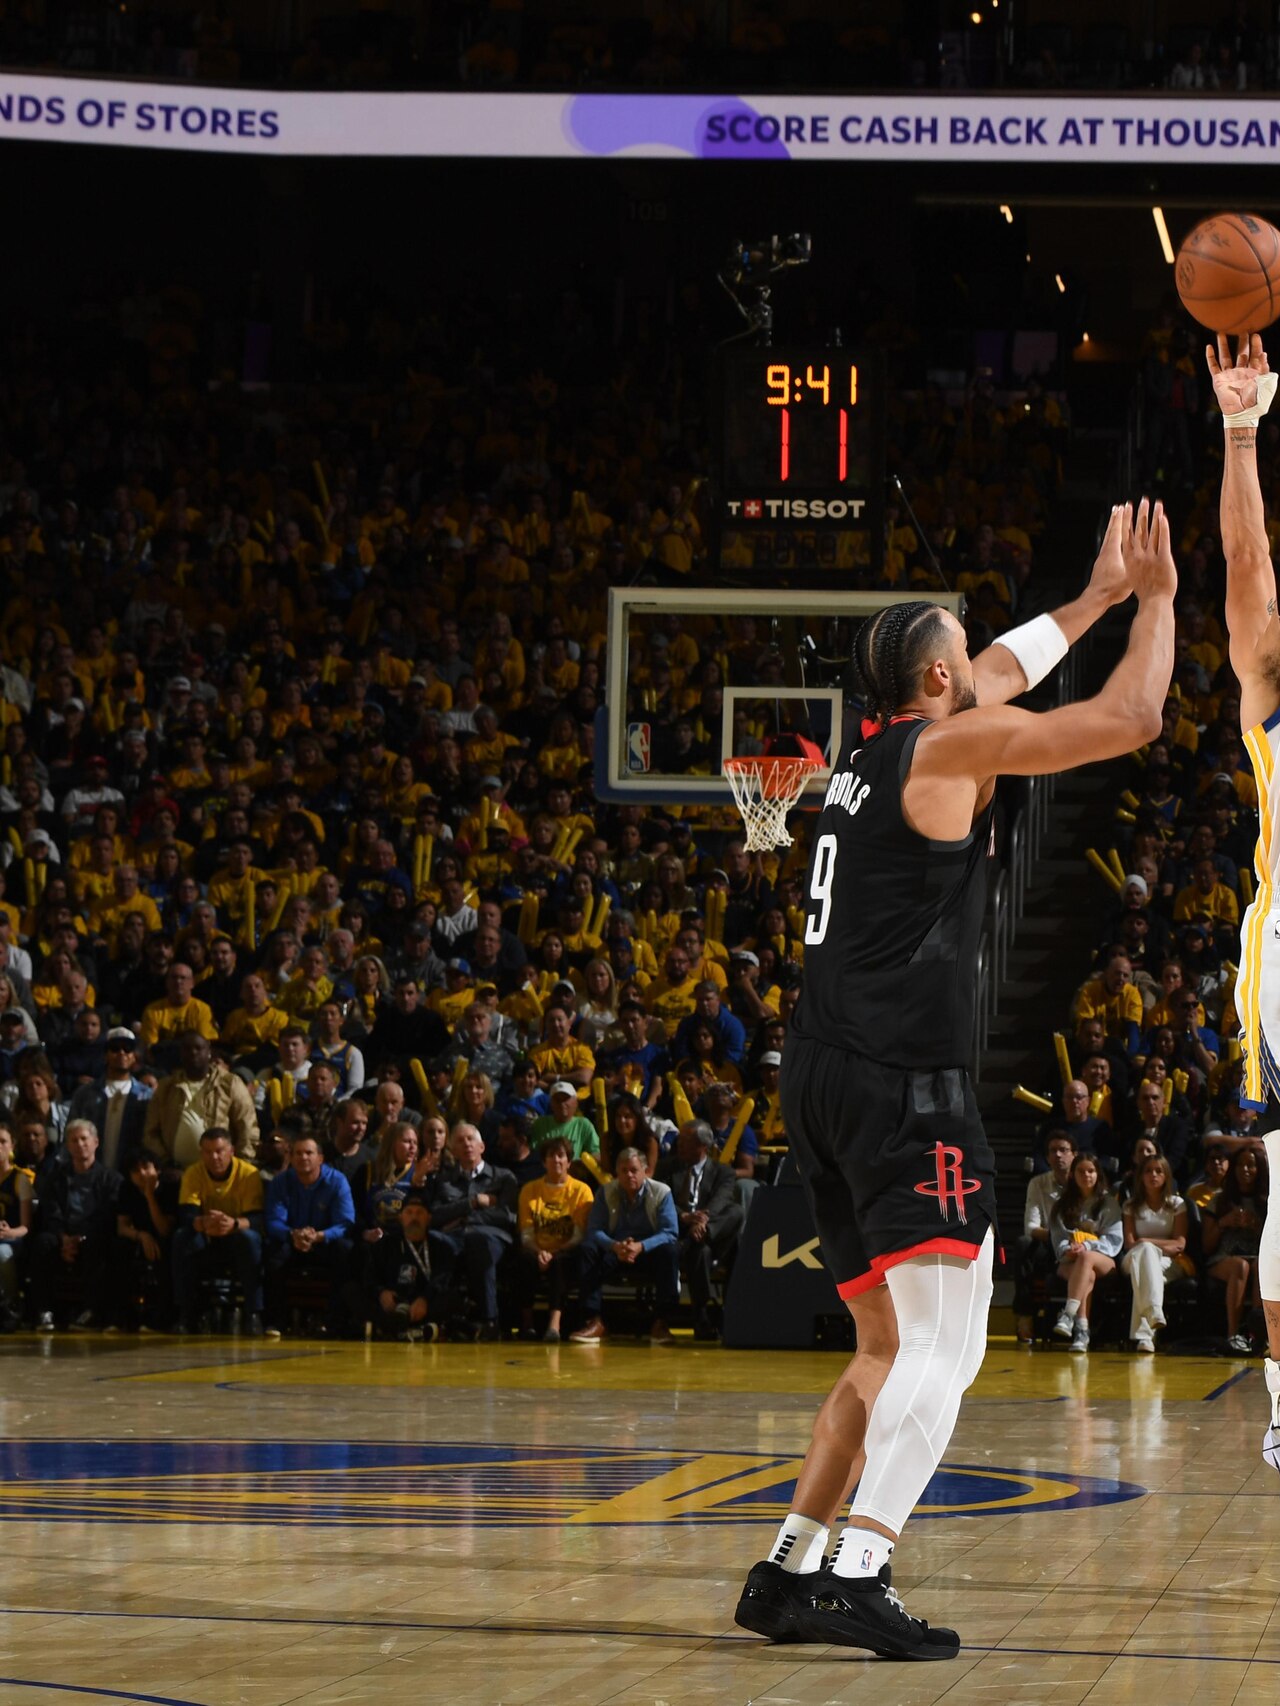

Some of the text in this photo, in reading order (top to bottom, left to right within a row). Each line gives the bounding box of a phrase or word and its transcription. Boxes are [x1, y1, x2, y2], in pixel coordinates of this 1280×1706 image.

[76, 99, 126, 128] OF
[136, 103, 279, 138] STORES
[705, 113, 830, 145] SCORE
[840, 115, 938, 145] CASH
[950, 117, 1048, 146] BACK
[1059, 118, 1104, 146] AT
[766, 364, 858, 406] 9:41
[764, 499, 866, 519] TISSOT
[804, 833, 837, 945] 9
